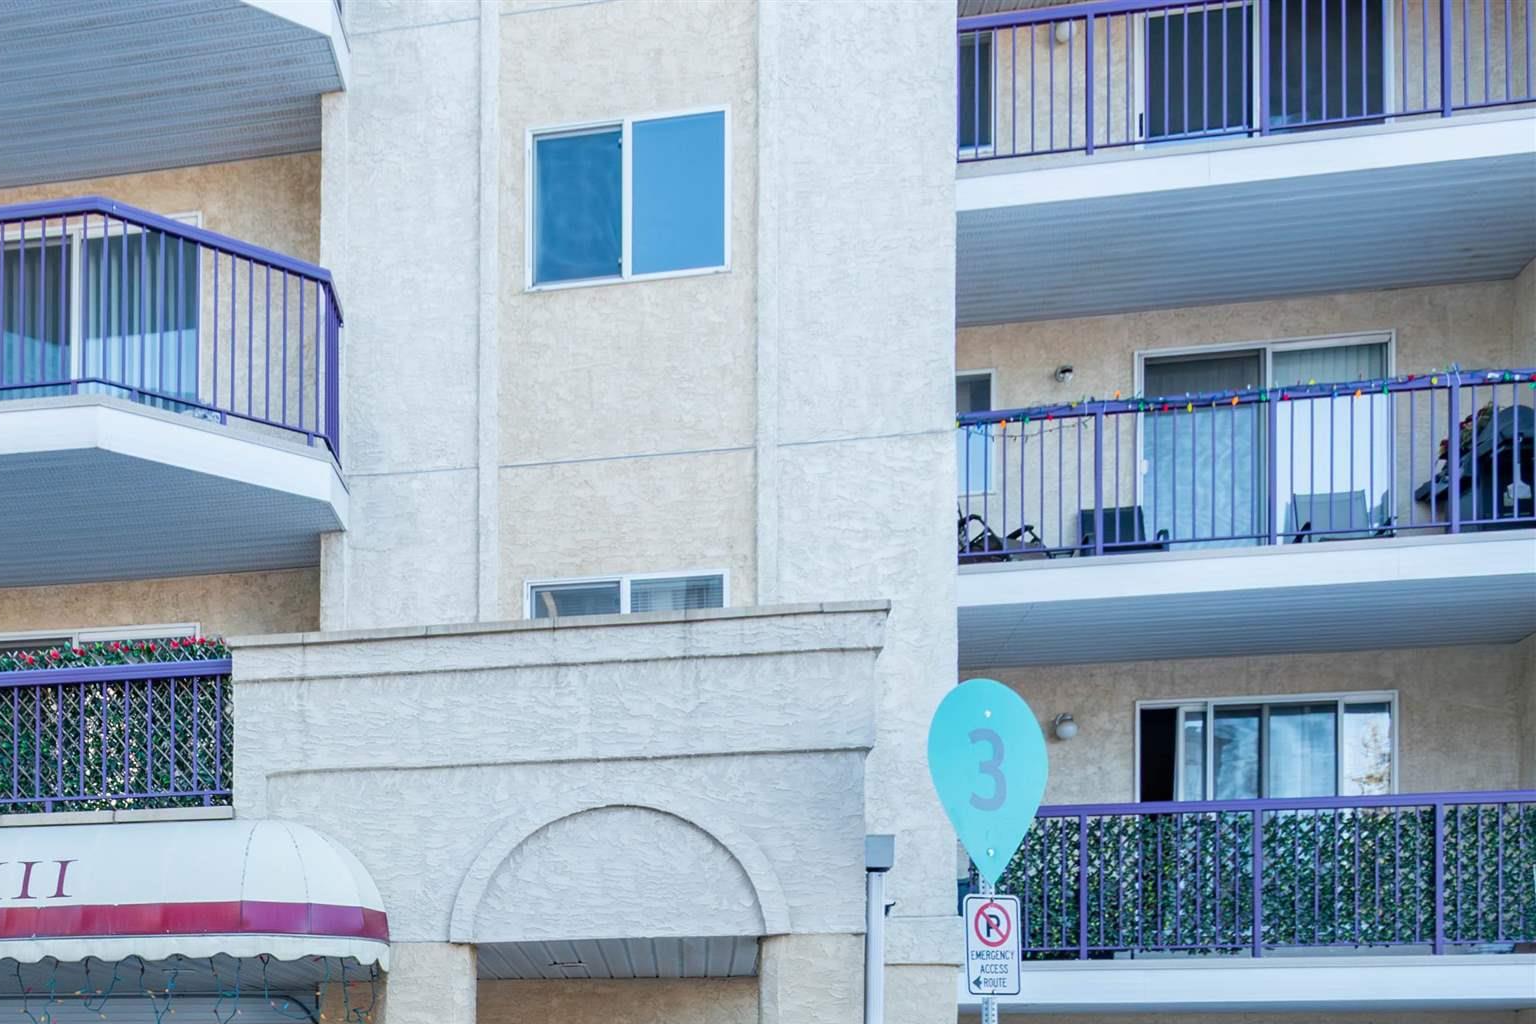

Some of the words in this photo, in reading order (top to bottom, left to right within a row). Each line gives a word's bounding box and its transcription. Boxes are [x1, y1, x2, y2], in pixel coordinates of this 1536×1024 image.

[968, 728, 1007, 811] 3
[970, 950, 1015, 960] EMERGENCY
[980, 964, 1009, 974] ACCESS
[984, 978, 1007, 988] ROUTE
